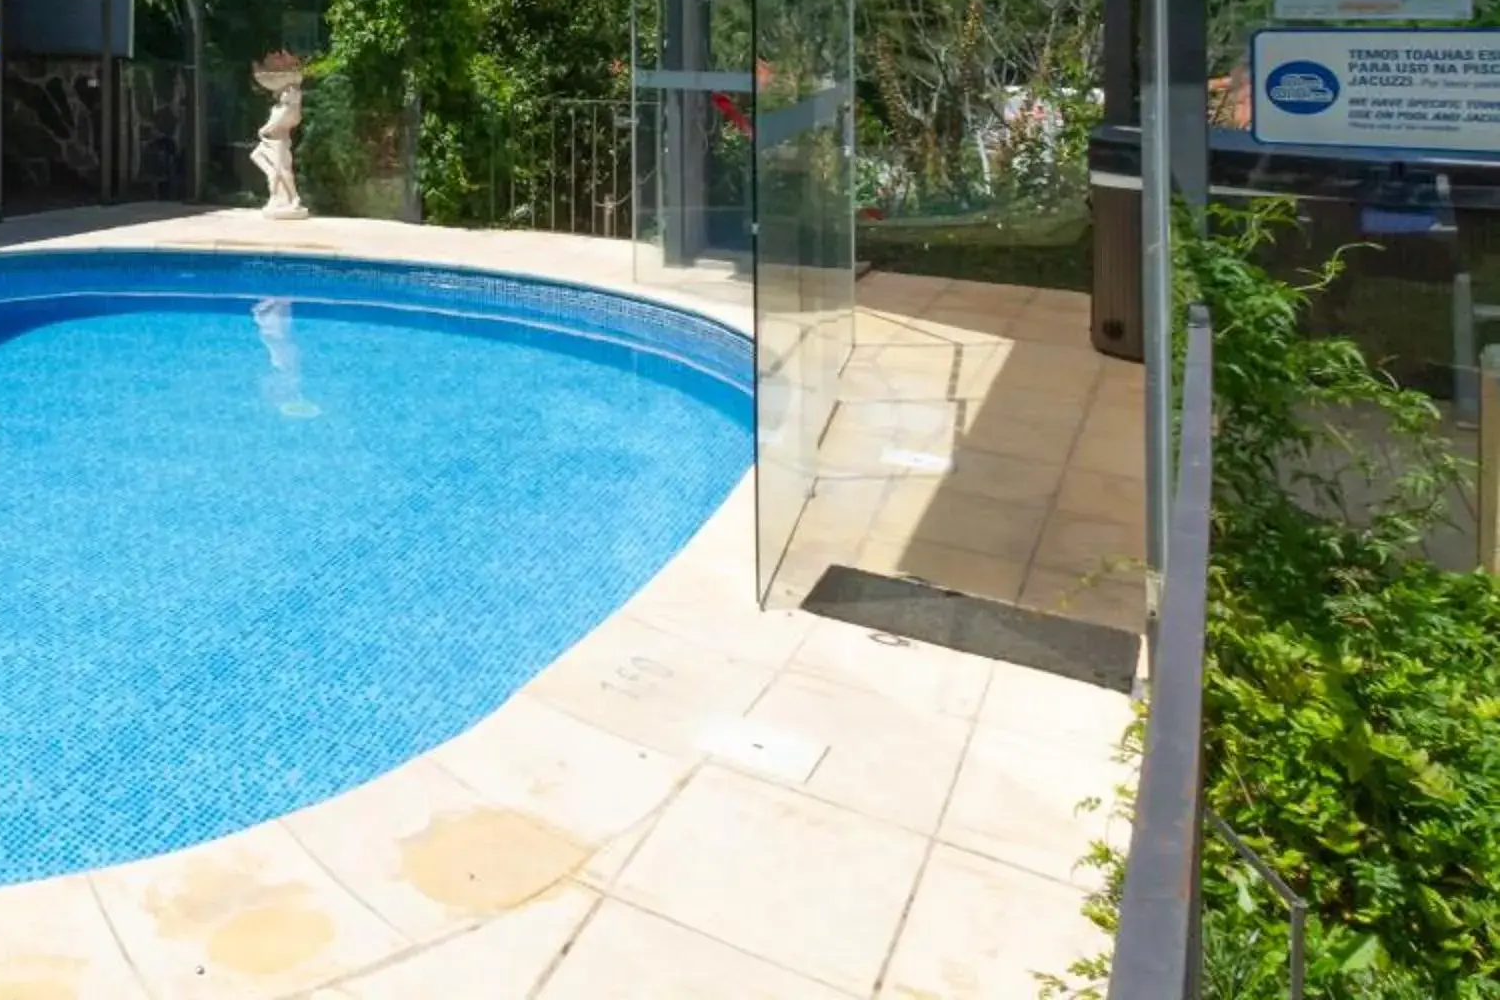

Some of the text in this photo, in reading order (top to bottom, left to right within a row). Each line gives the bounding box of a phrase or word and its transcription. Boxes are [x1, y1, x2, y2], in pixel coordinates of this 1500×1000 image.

[1348, 49, 1399, 60] TEMOS
[1405, 49, 1475, 61] TOALHAS
[1348, 62, 1392, 73] PARA
[1396, 62, 1429, 74] USO
[1433, 63, 1458, 74] NA
[1347, 75, 1413, 87] JACUZZI
